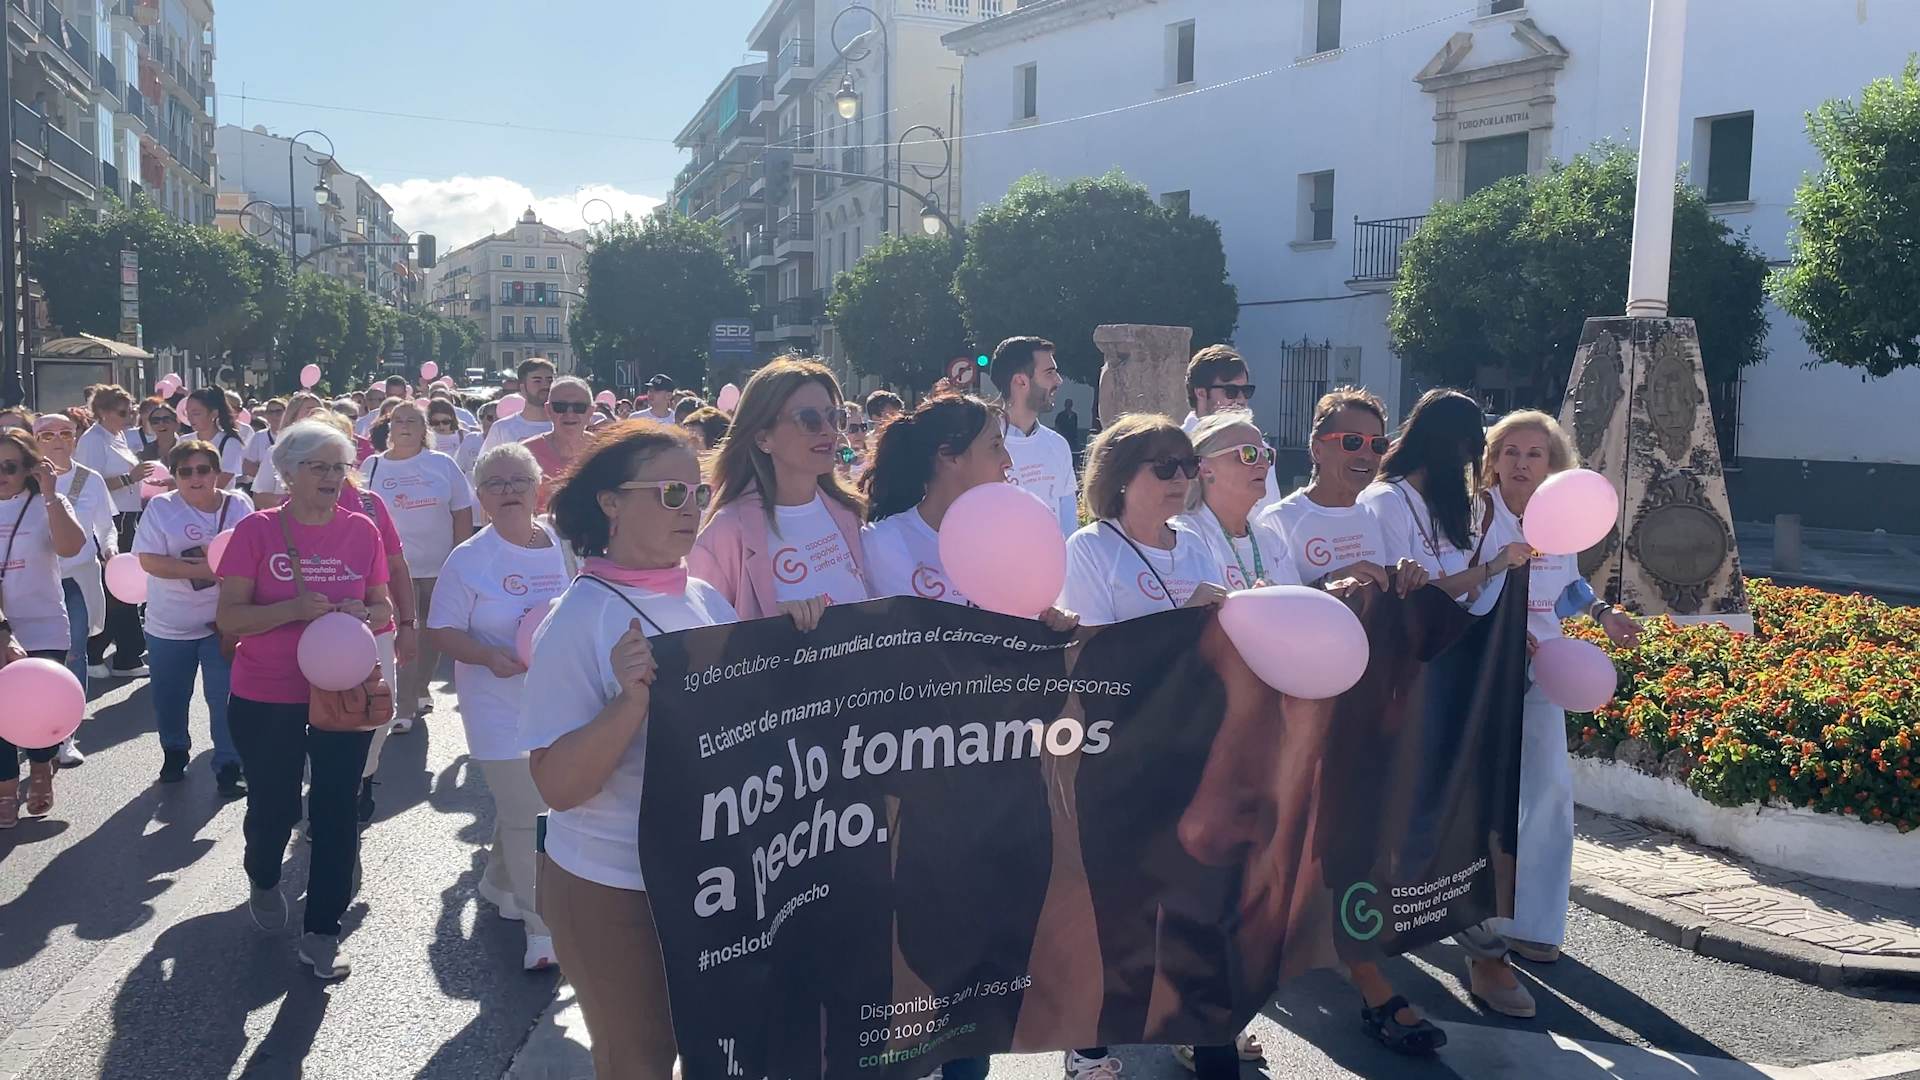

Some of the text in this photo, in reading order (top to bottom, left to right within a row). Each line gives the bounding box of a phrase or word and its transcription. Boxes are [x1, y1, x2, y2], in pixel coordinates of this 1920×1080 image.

[1505, 111, 1530, 124] PATRIA
[683, 672, 700, 692] 19
[702, 665, 722, 685] de
[724, 654, 780, 680] octubre
[793, 647, 817, 665] Día
[819, 633, 875, 661] mundial
[875, 628, 921, 648] contra
[924, 626, 941, 642] el
[942, 627, 1002, 646] cáncer
[1002, 634, 1027, 652] de
[699, 673, 1132, 758] El cáncer de mama y cómo lo viven miles de personas
[700, 717, 1115, 841] nos lo tomamos
[693, 798, 888, 921] a pecho.
[1391, 857, 1487, 898] asociación española
[1392, 881, 1472, 915] contra el cáncer
[1394, 906, 1448, 932] en Málaga
[698, 883, 830, 972] #noslotomosapecho
[860, 995, 950, 1021] Disponibles
[980, 981, 1009, 996] 365
[858, 1022, 977, 1068] contraelcer.es
[859, 1013, 950, 1047] 900 100 036
